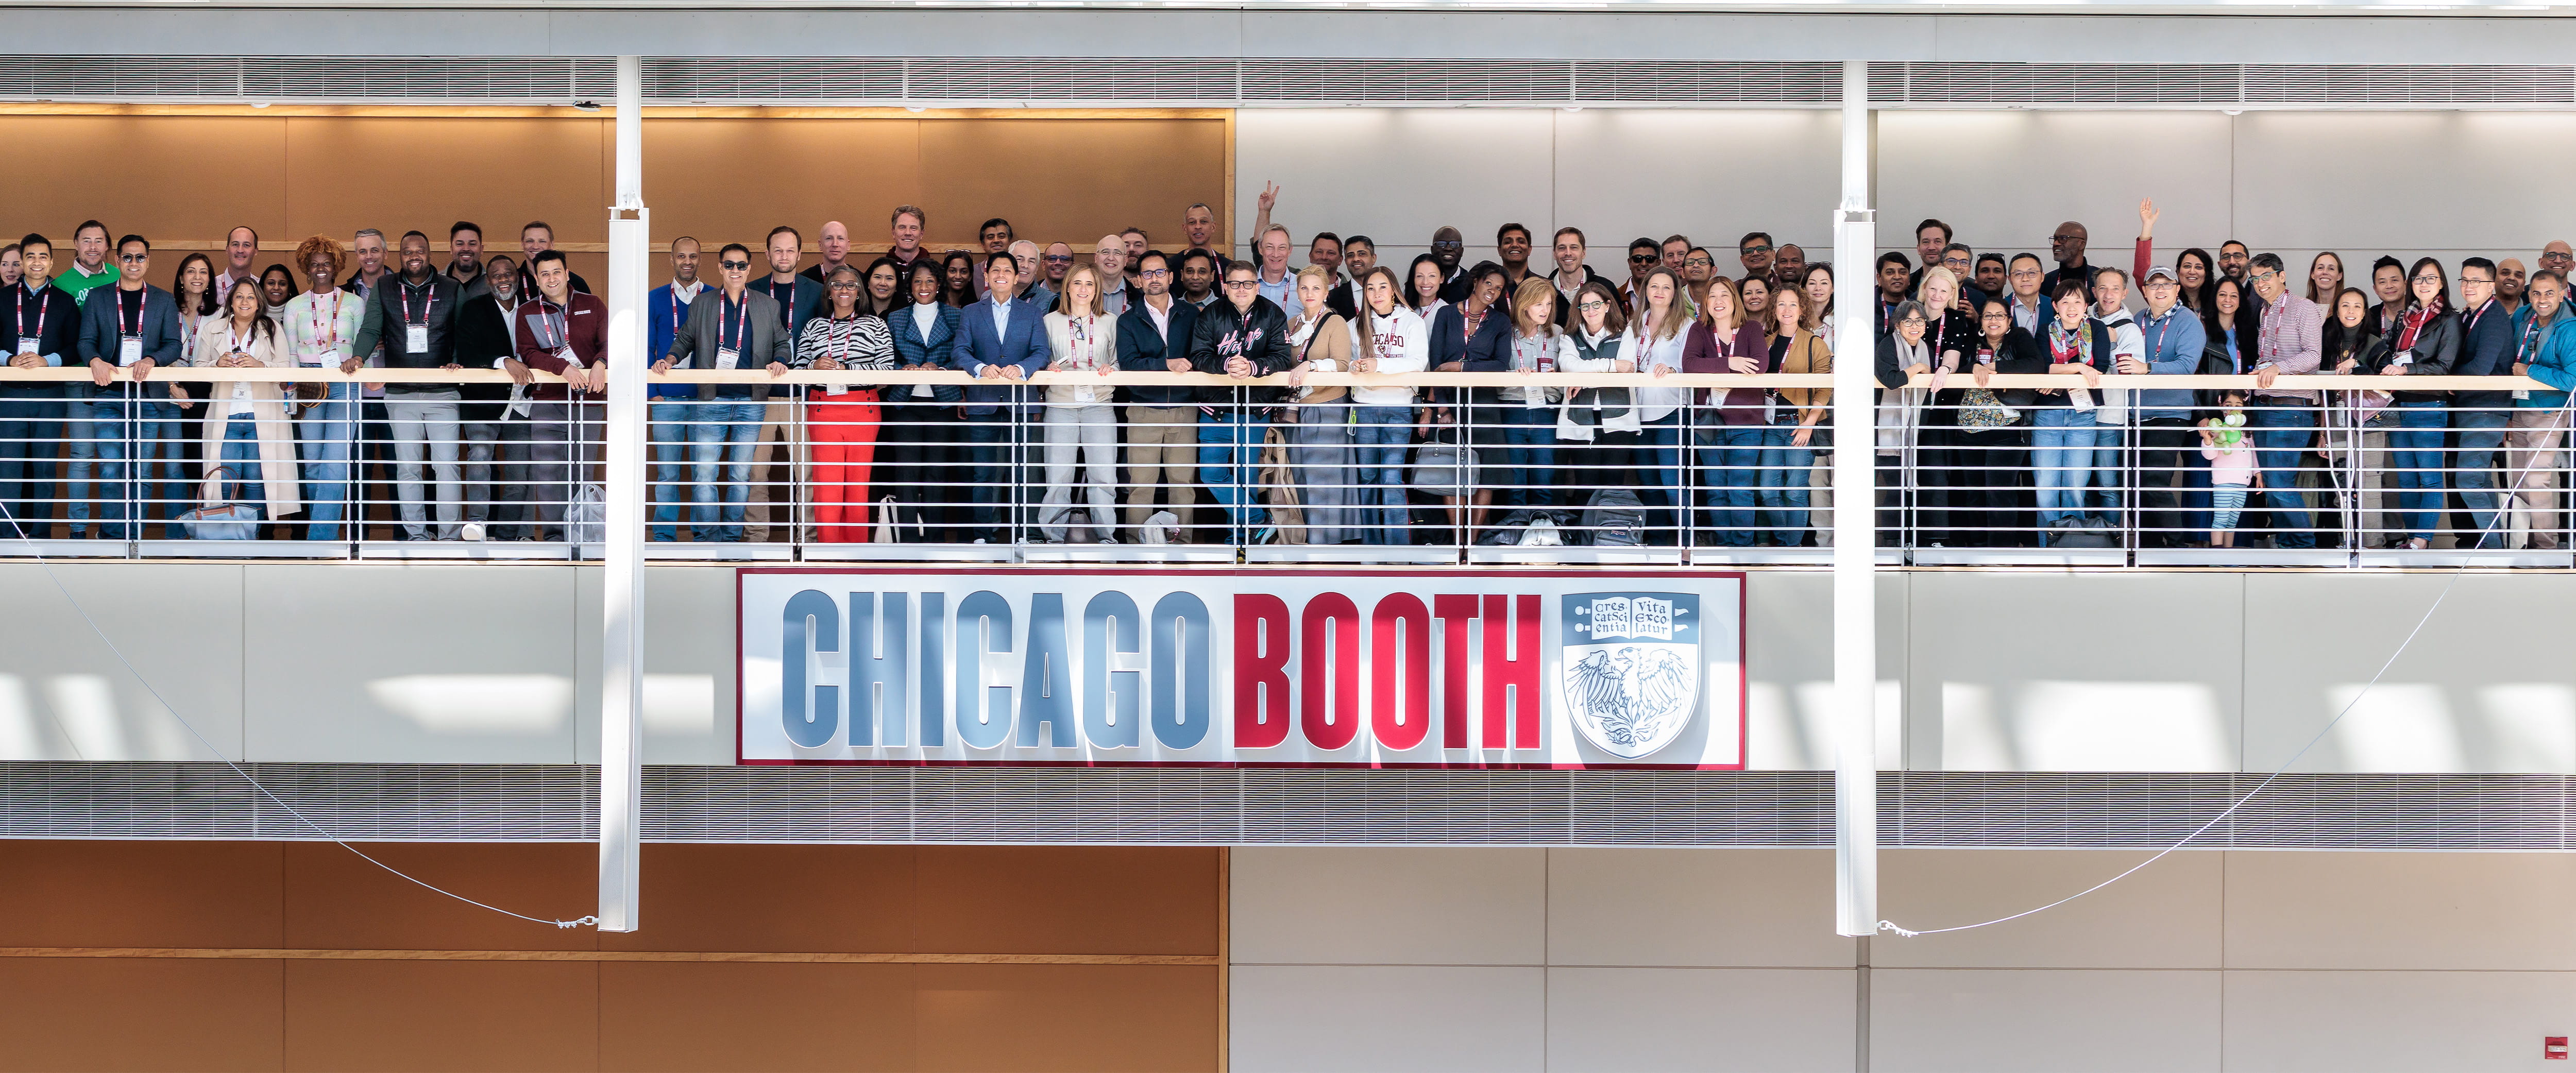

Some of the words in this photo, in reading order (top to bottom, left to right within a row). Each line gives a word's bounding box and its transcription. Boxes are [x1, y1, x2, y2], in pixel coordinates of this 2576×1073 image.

[1636, 601, 1666, 614] Vita
[1596, 622, 1627, 633] entia
[1635, 623, 1668, 635] latur
[782, 589, 1210, 750] CHICAGO
[1233, 592, 1541, 751] BOOTH
